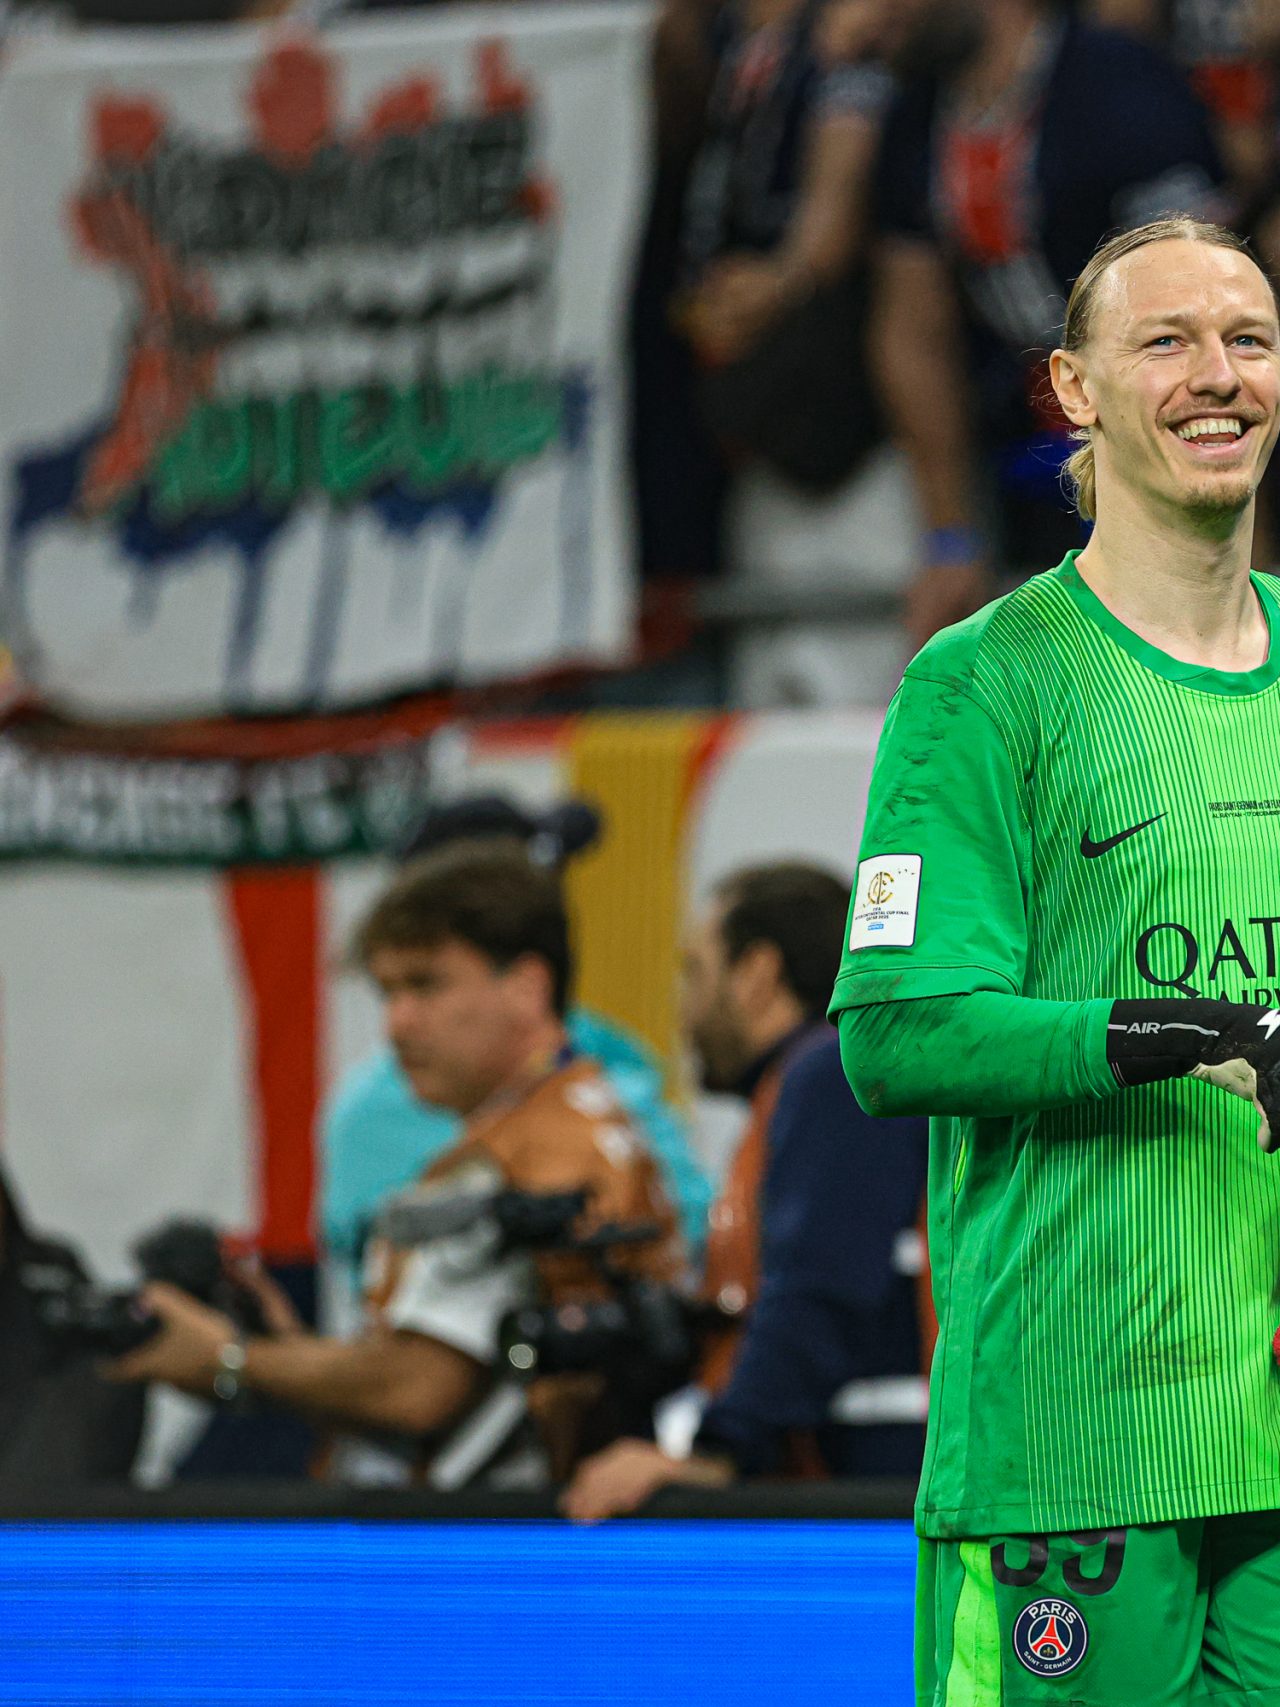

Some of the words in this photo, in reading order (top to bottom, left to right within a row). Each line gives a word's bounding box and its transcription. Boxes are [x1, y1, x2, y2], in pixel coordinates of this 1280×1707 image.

[1127, 1022, 1161, 1034] AIR
[1028, 1602, 1077, 1624] PARIS
[1023, 1650, 1040, 1667] SAINT
[1043, 1656, 1072, 1670] GERMAIN
